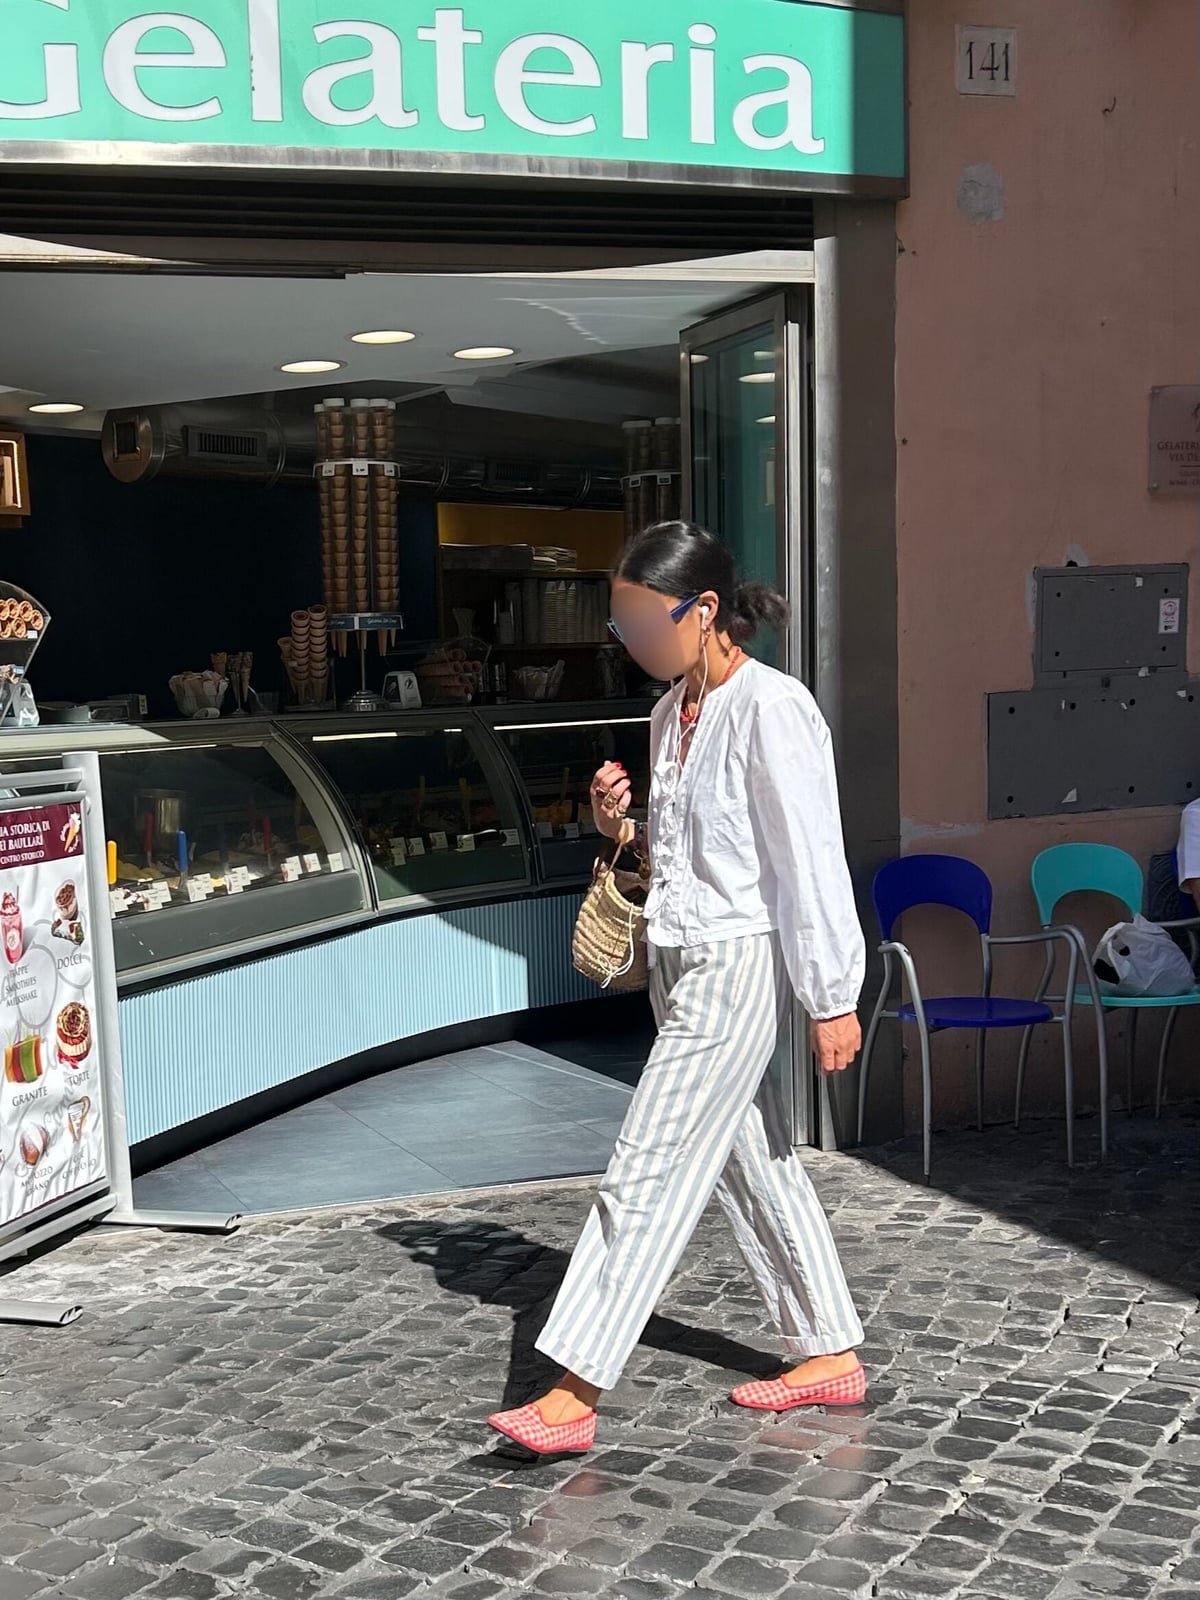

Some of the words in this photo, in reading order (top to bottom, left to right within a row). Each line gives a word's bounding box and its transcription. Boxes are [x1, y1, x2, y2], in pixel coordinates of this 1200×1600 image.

[965, 41, 1010, 81] 141
[10, 822, 42, 836] STORICA
[21, 850, 45, 861] STORICO
[57, 953, 82, 970] DOLCI
[67, 1070, 90, 1087] TORTE
[12, 1086, 48, 1107] GRANITE
